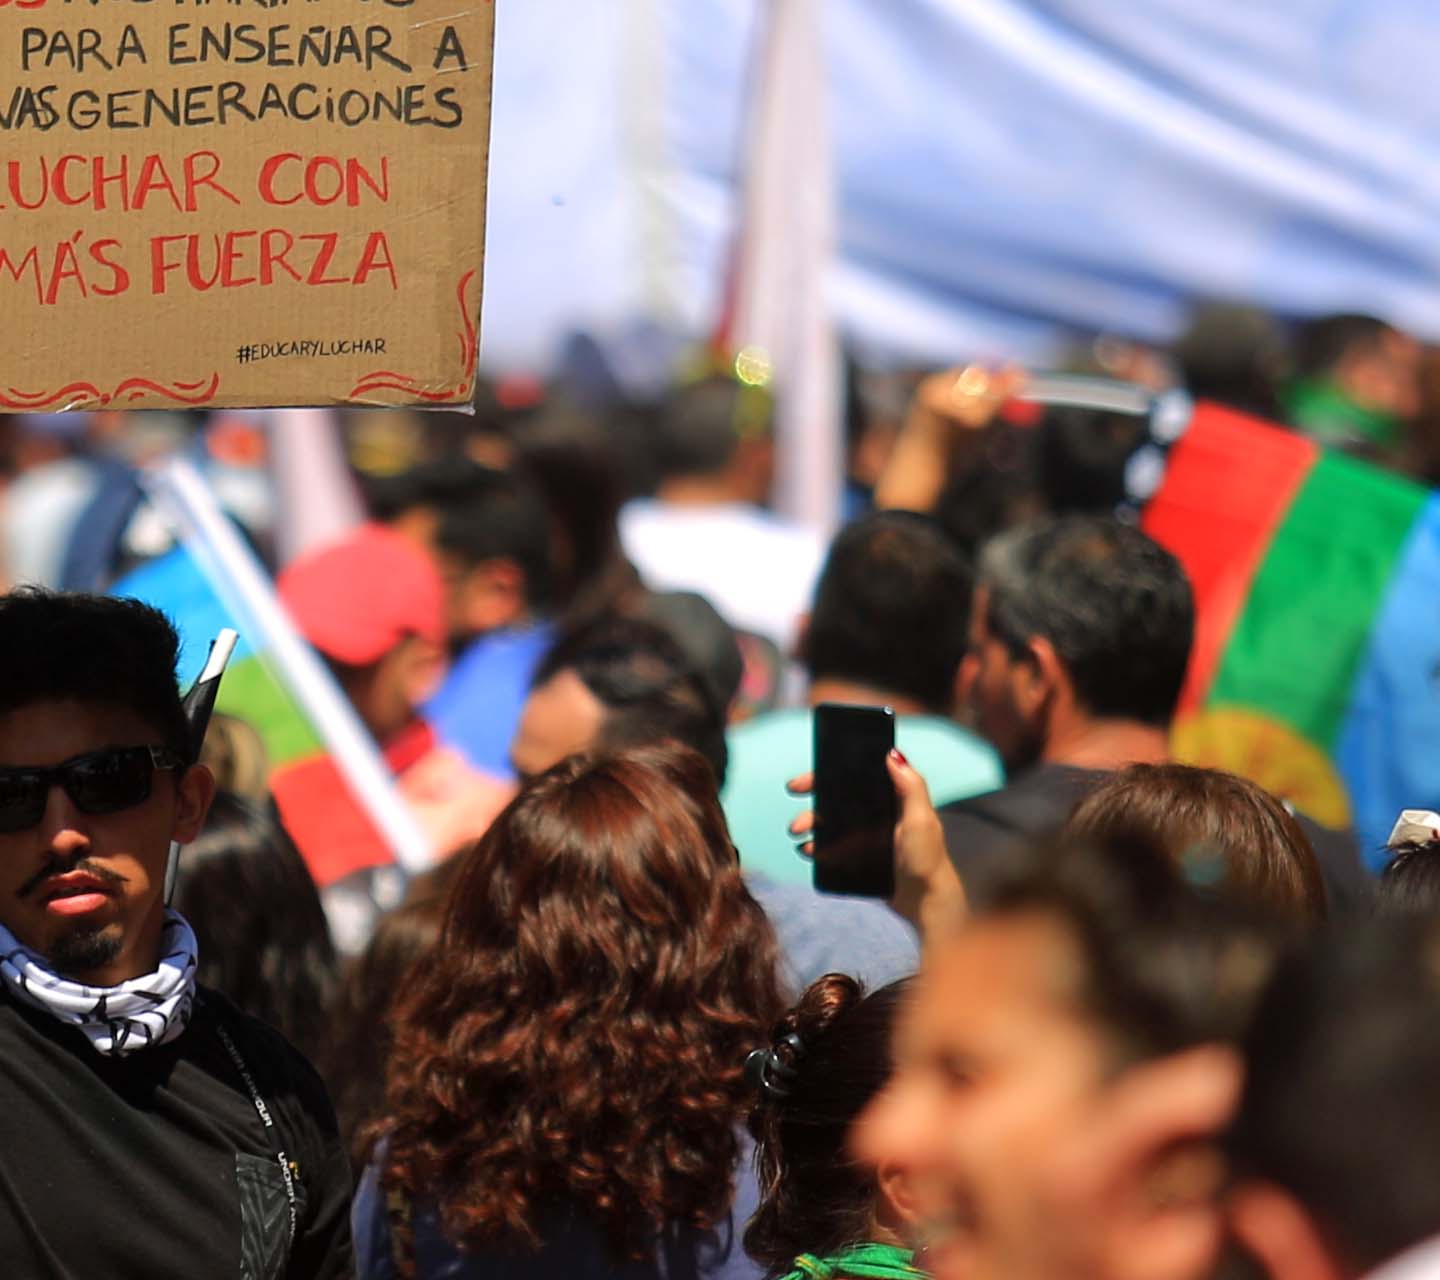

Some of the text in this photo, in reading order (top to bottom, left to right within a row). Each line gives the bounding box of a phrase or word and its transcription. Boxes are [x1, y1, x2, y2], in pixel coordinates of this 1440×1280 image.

[22, 25, 146, 72] PARA
[169, 23, 412, 73] ENSEÑAR
[433, 26, 468, 72] A
[259, 153, 387, 206] CON
[151, 229, 396, 293] FUERZA
